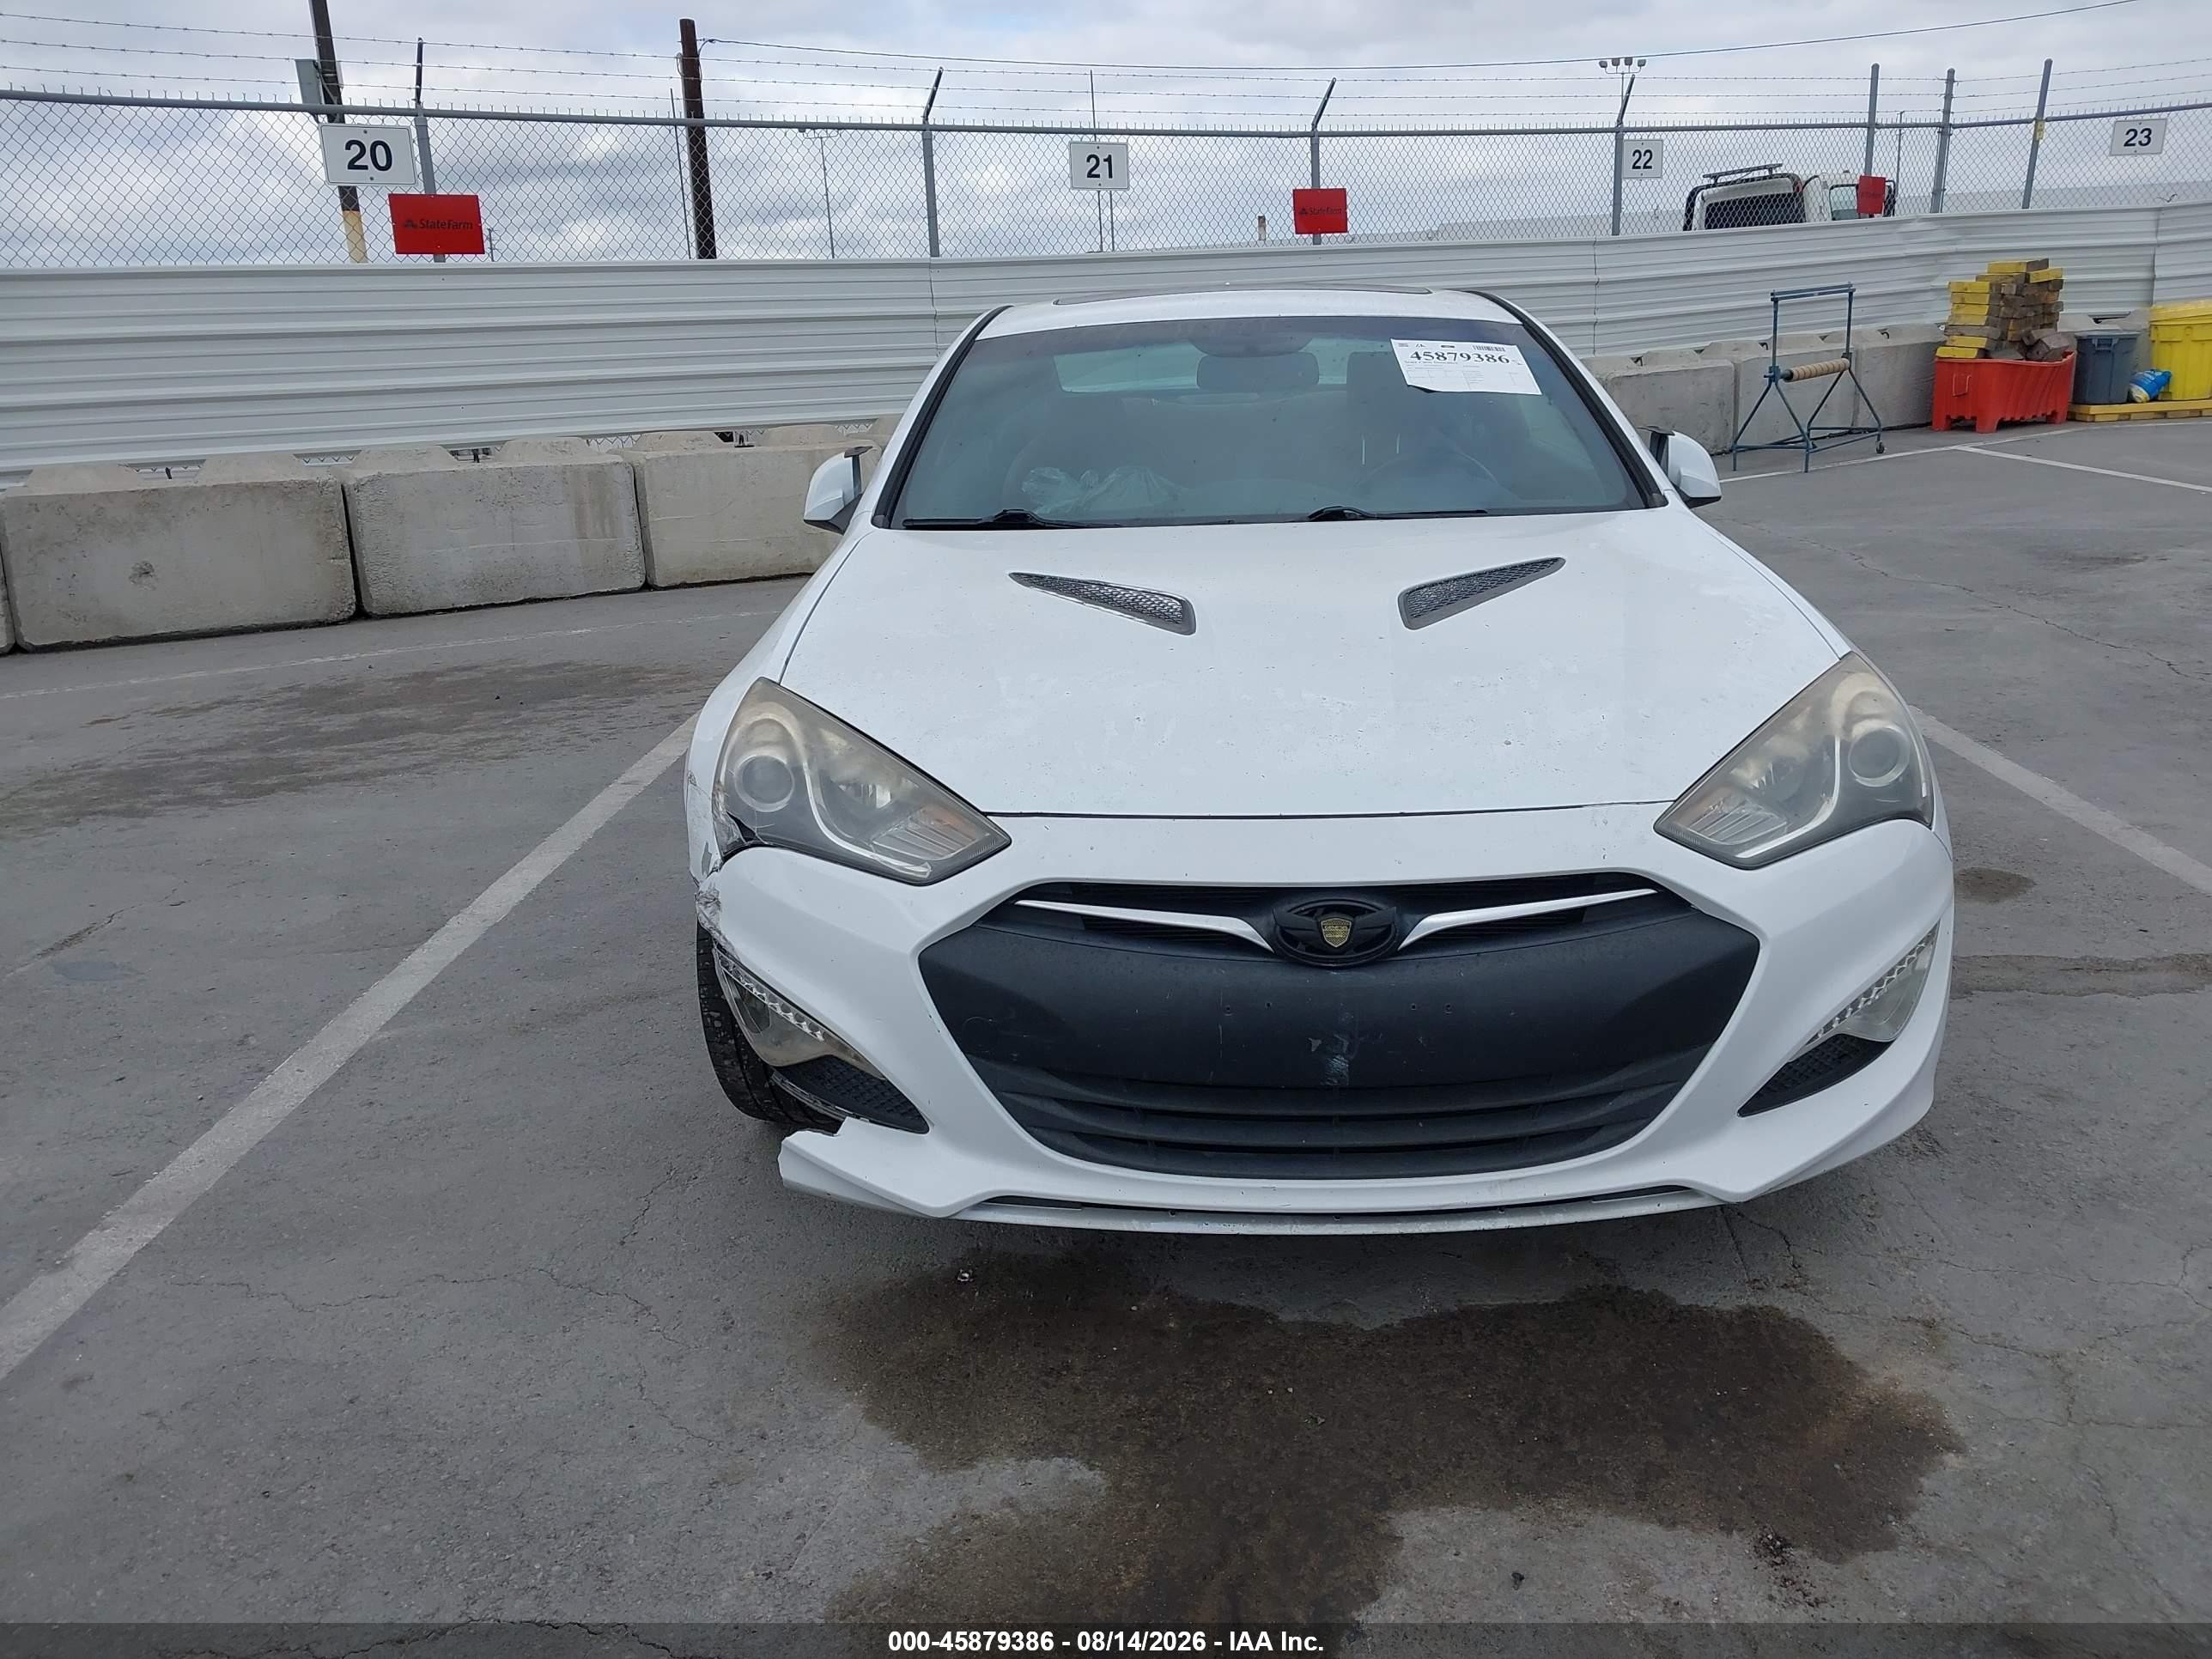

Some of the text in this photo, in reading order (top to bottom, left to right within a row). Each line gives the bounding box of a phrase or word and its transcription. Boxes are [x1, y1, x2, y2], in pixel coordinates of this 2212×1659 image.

[2123, 127, 2152, 147] 23
[344, 139, 392, 172] 20
[1632, 149, 1653, 170] 22
[1085, 154, 1113, 179] 21
[1410, 350, 1510, 364] 45879386
